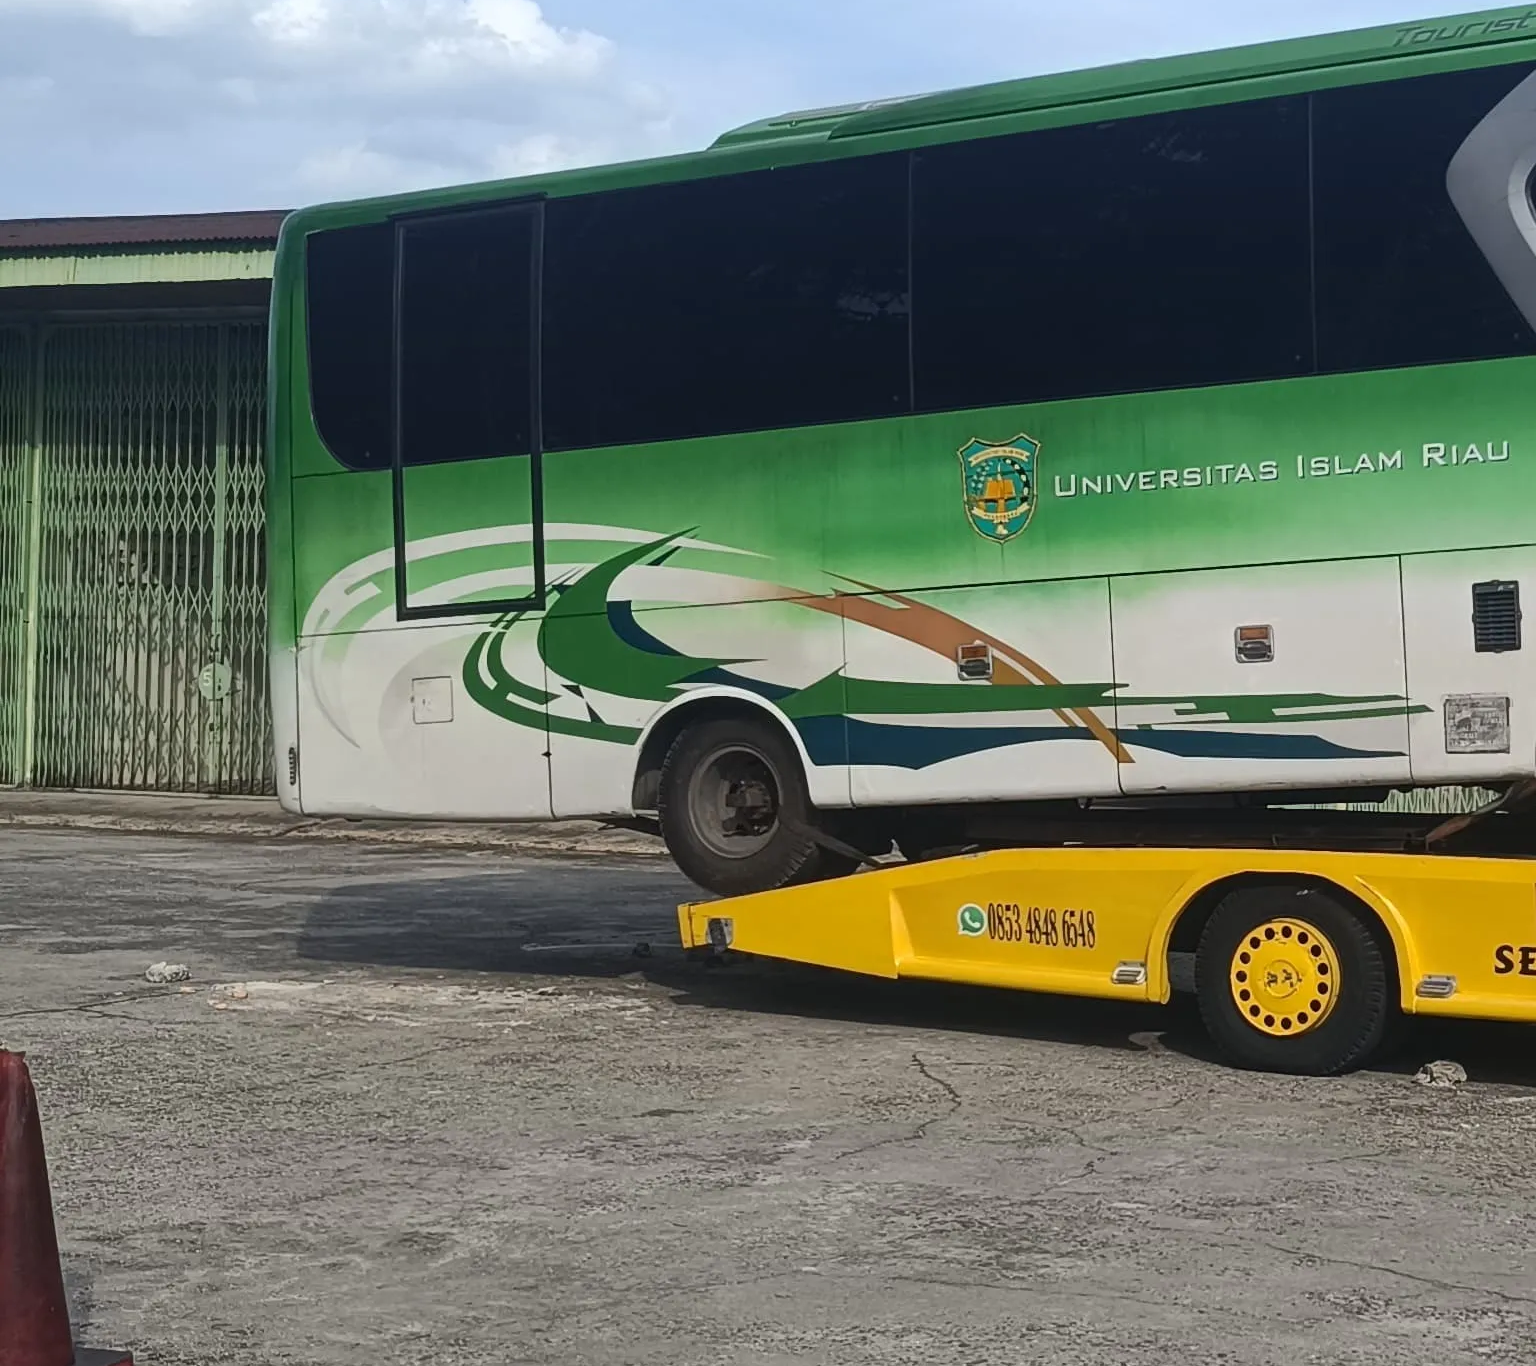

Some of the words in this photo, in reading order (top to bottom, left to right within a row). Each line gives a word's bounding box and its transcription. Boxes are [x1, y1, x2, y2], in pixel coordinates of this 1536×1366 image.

[1054, 460, 1279, 498] UNIVERSITAS
[1297, 450, 1403, 478] ISLAM
[1422, 441, 1510, 467] RIAU
[987, 903, 1022, 942] 0853
[1025, 906, 1059, 947] 4848
[1062, 909, 1096, 949] 6548
